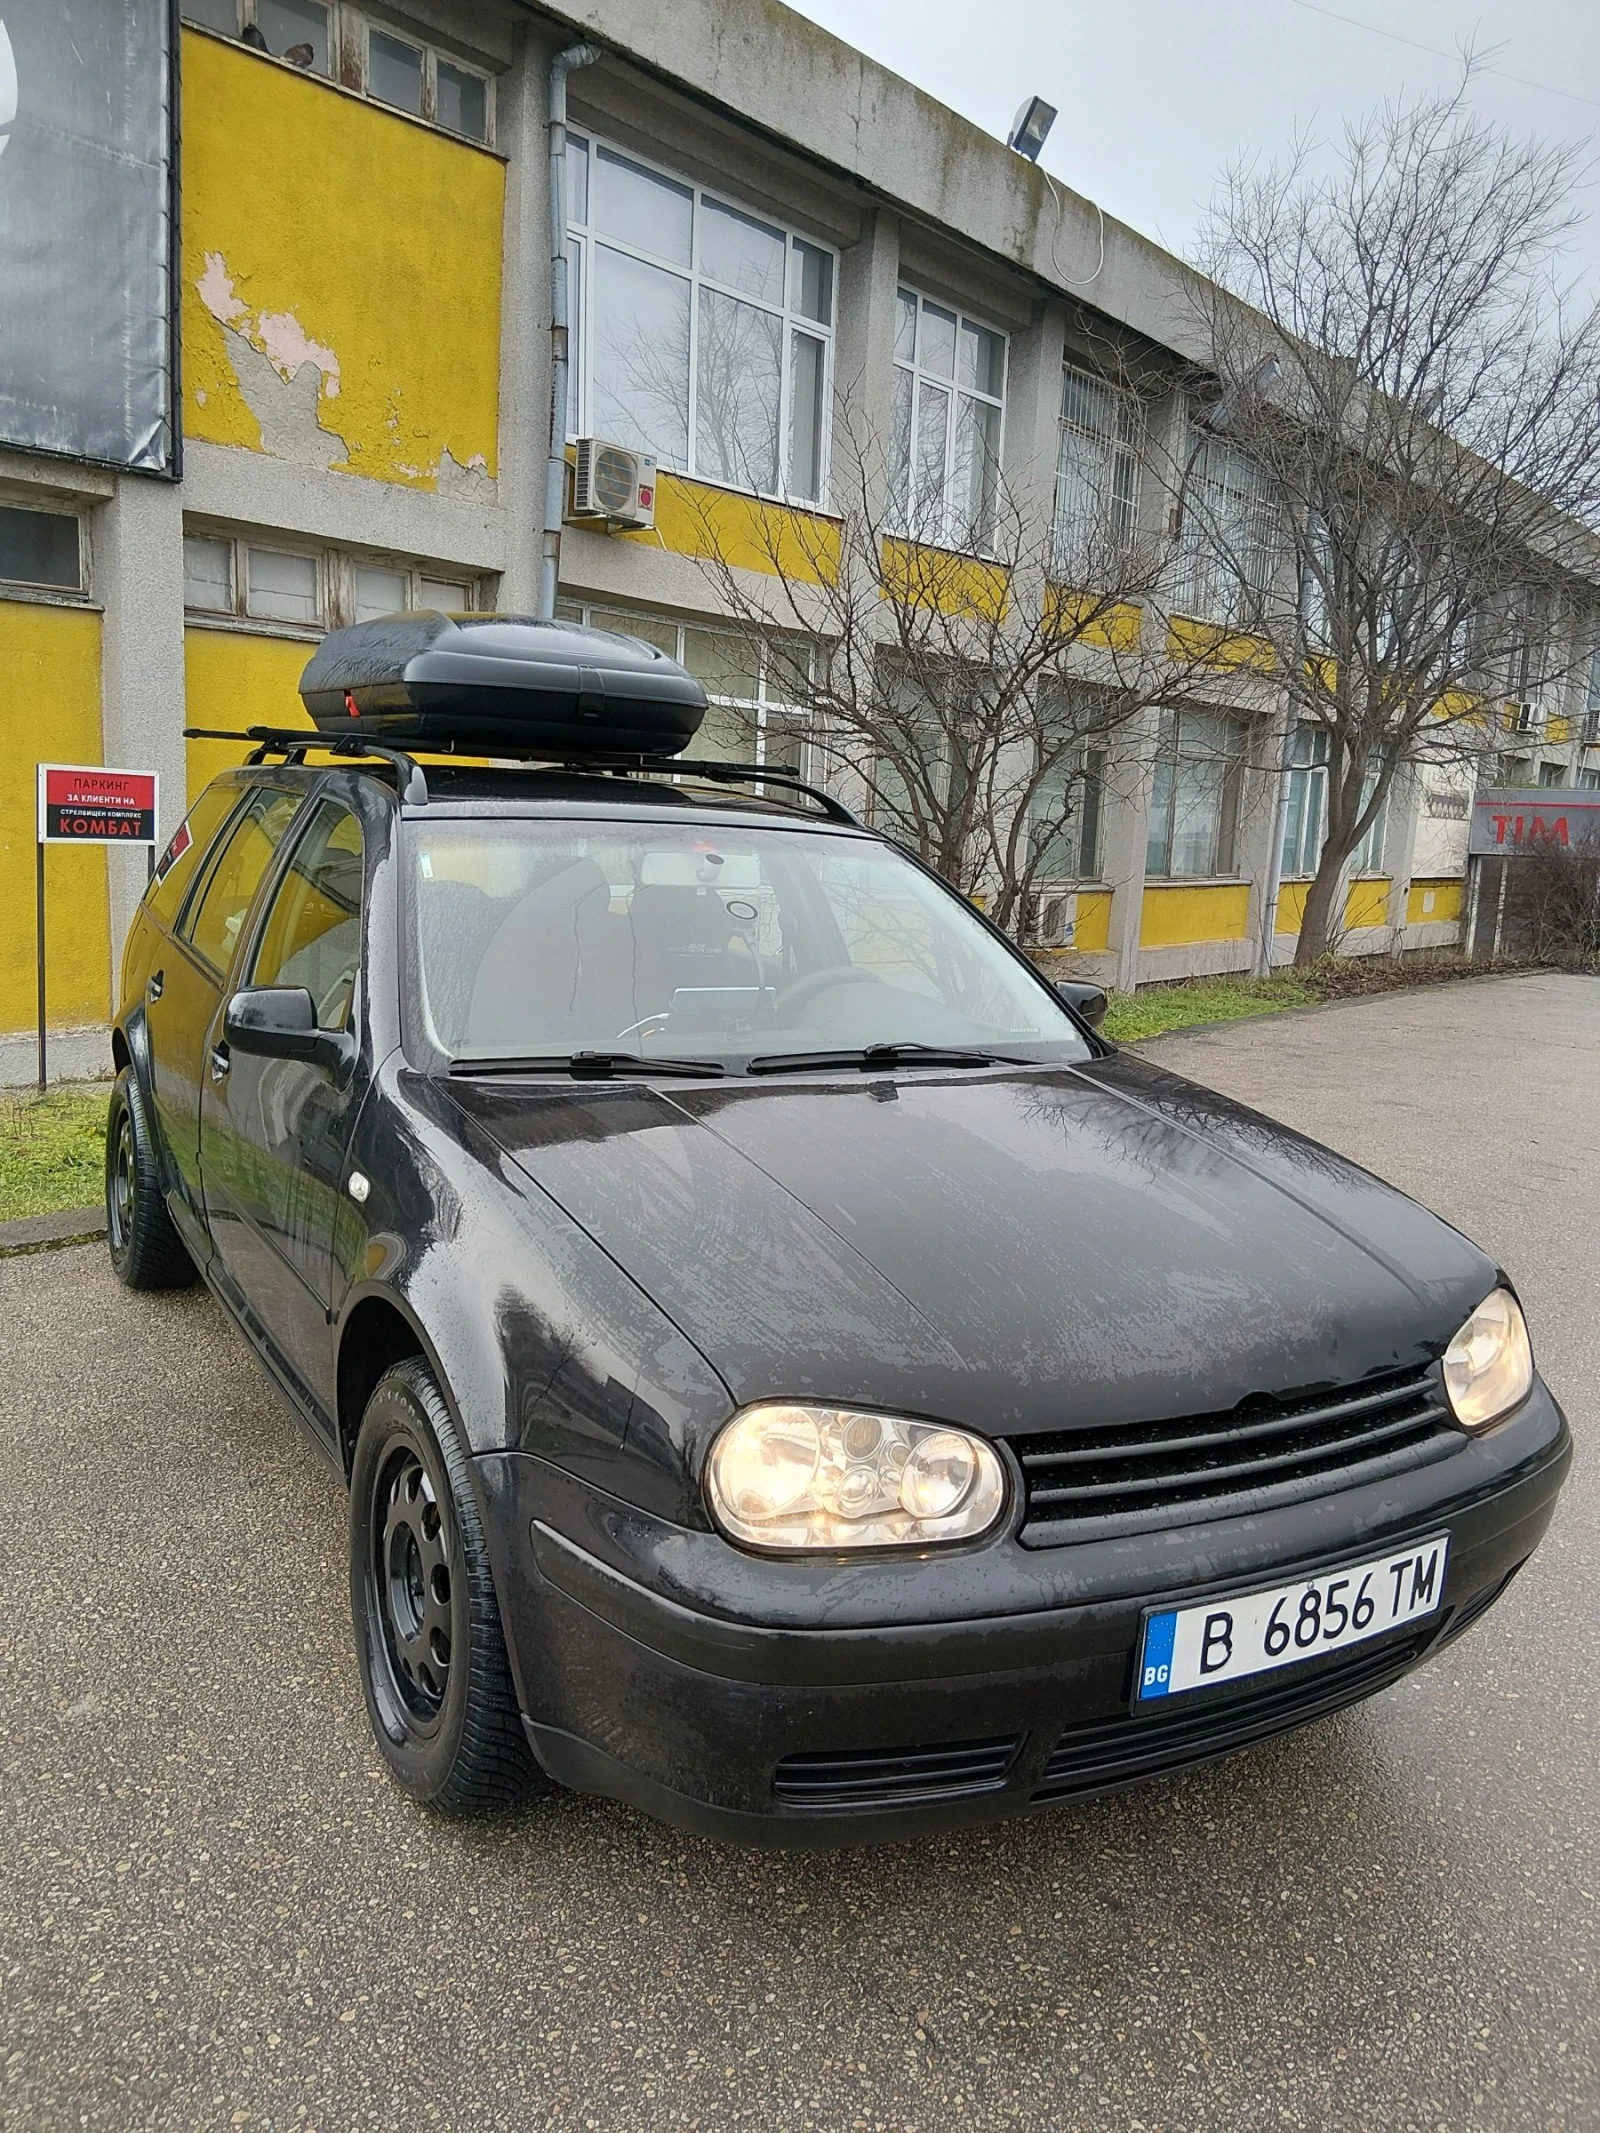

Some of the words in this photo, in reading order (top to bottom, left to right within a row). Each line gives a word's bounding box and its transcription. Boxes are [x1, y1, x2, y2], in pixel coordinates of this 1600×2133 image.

[74, 778, 129, 791] ПАРКИНГ
[67, 794, 79, 802] ЗА
[81, 795, 122, 804] КЛИЕНТИ
[124, 797, 135, 805] НА
[60, 809, 106, 817] СТРЕЛБИЩЕН
[108, 811, 142, 819] КОМПЛЕКС
[60, 819, 142, 836] КОМБАТ
[1492, 815, 1569, 846] TIM
[1200, 1611, 1233, 1675] B
[1264, 1572, 1375, 1656] 6856
[1389, 1549, 1439, 1618] TM
[1144, 1665, 1168, 1686] BG
